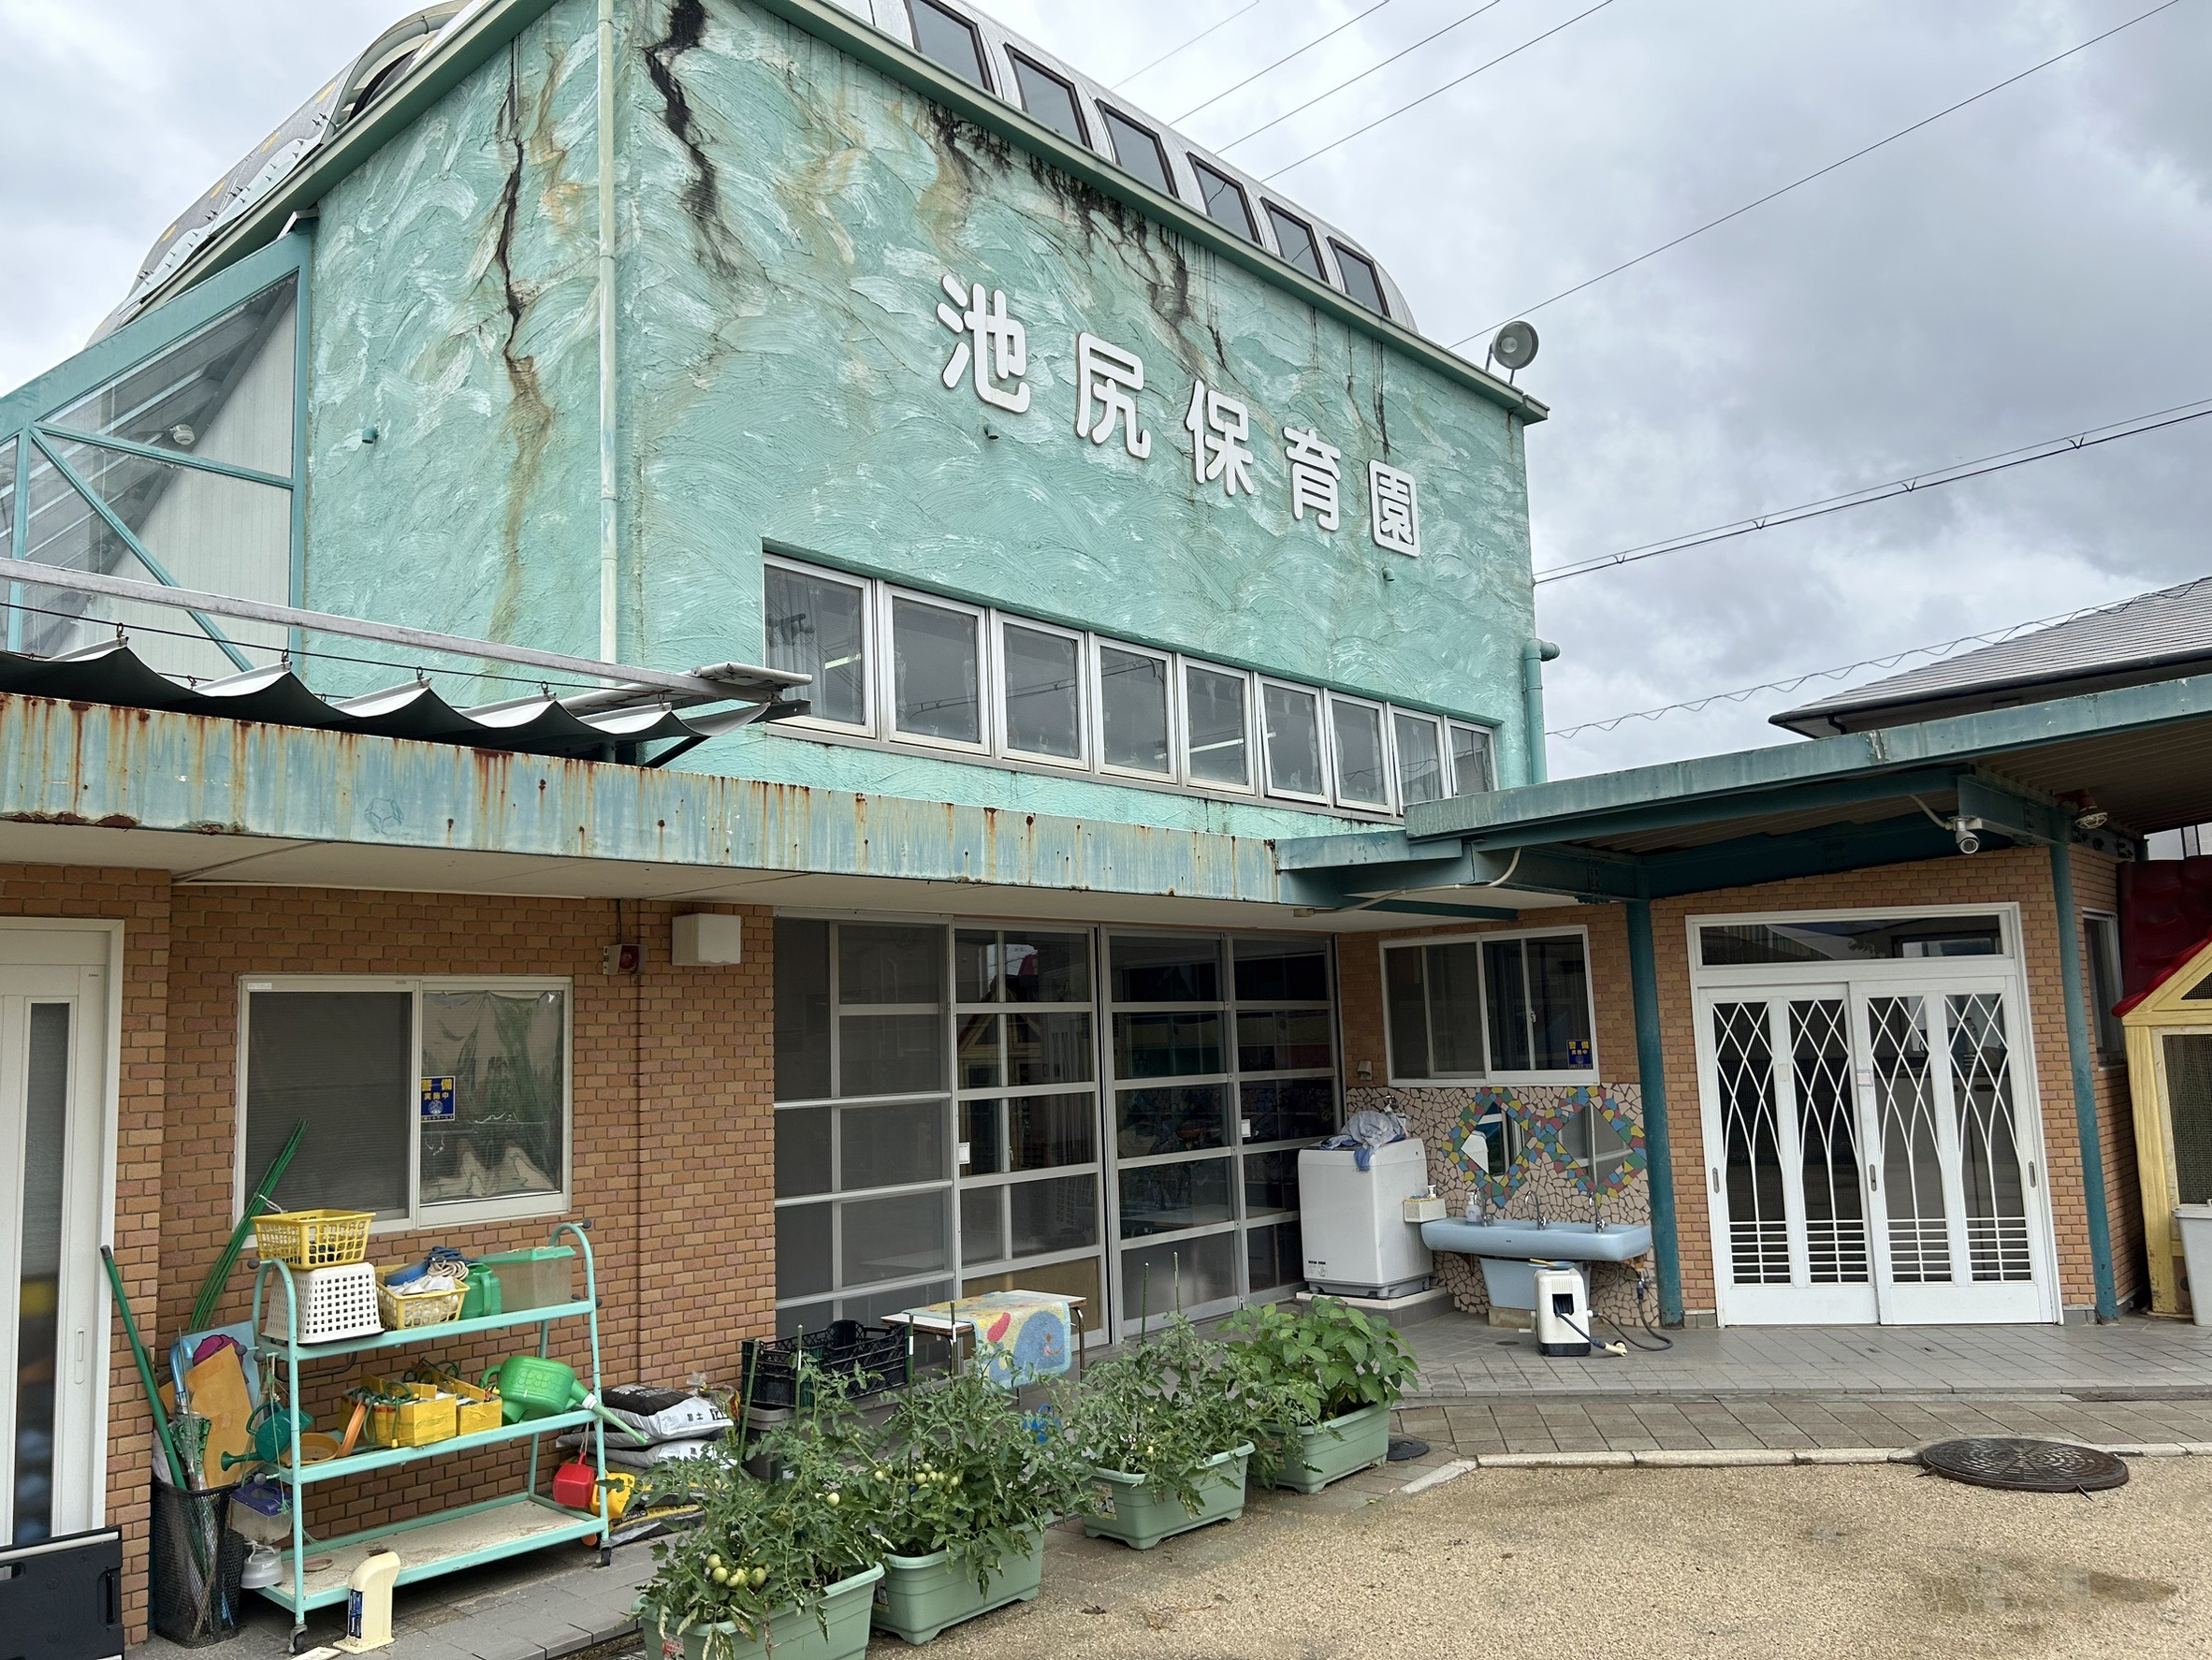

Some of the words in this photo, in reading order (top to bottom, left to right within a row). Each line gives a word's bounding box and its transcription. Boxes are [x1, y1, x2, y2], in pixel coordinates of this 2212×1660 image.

[937, 274, 1421, 558] 池尻保育園
[421, 1078, 453, 1092] 警備
[424, 1091, 449, 1100] 実施中
